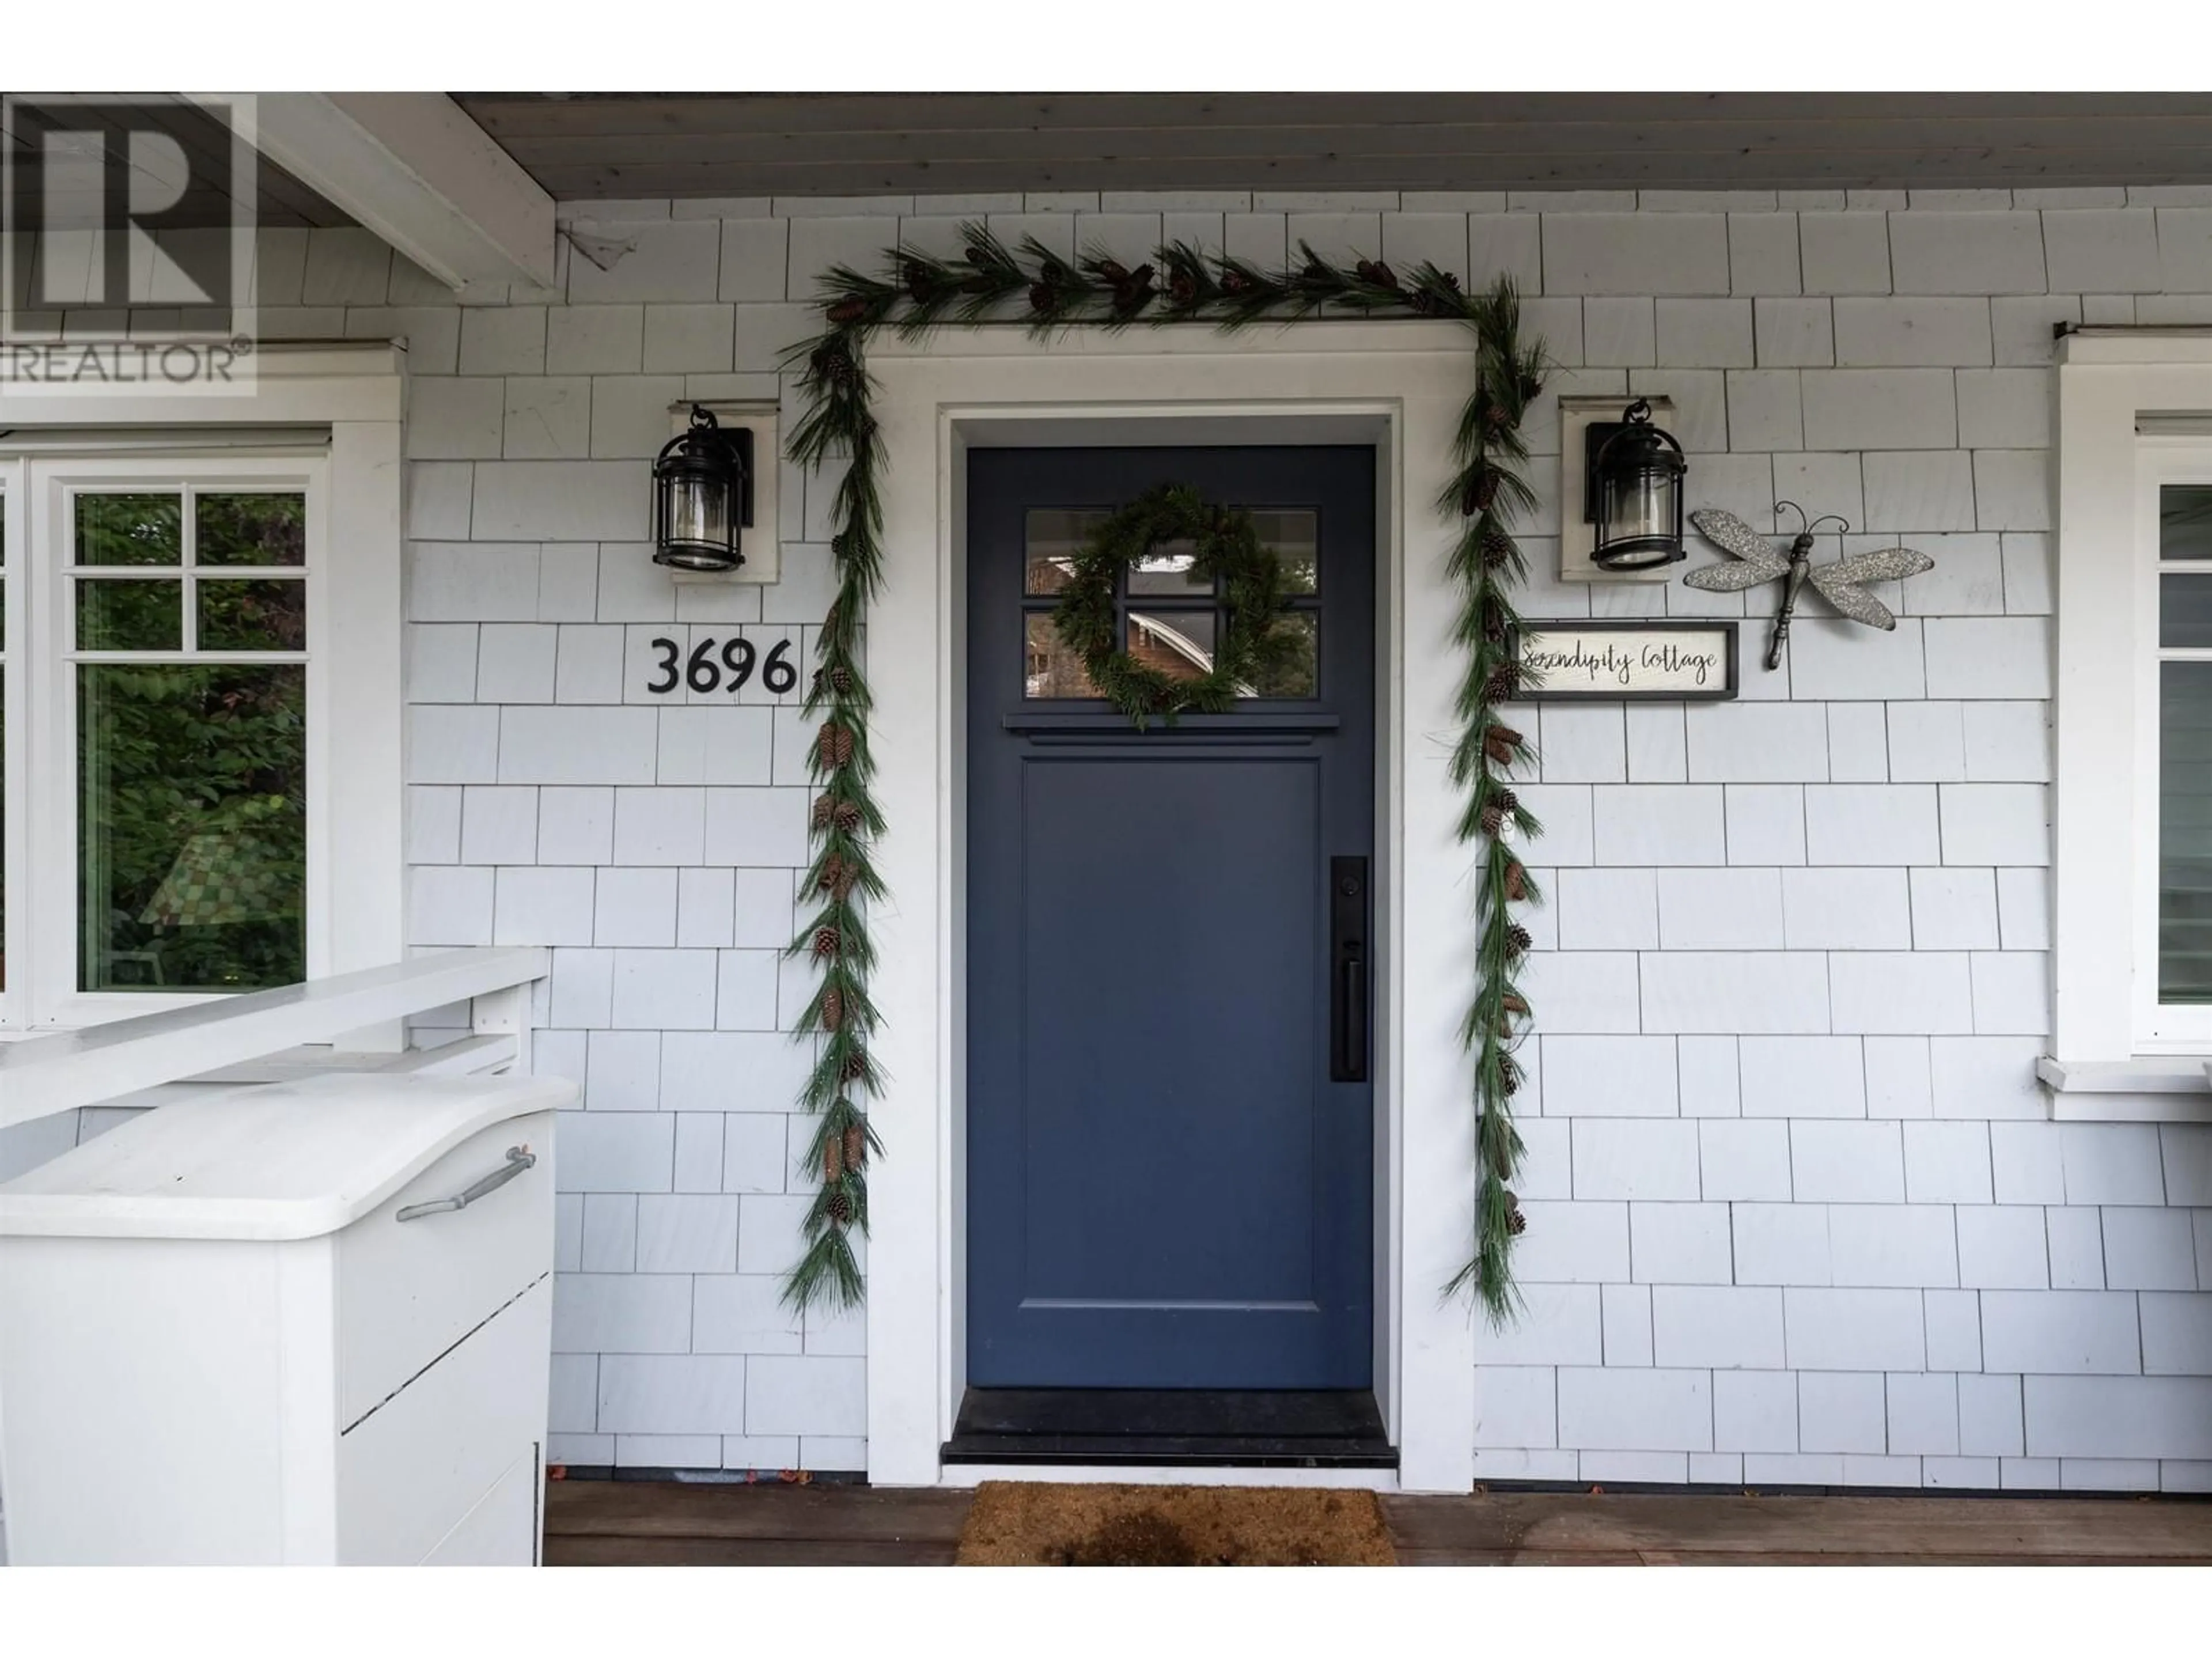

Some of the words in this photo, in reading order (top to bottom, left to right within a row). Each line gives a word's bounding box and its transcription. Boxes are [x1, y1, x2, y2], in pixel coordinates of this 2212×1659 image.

[647, 637, 797, 694] 3696
[1522, 639, 1635, 685] Serendipity
[1642, 643, 1717, 685] Cottage
